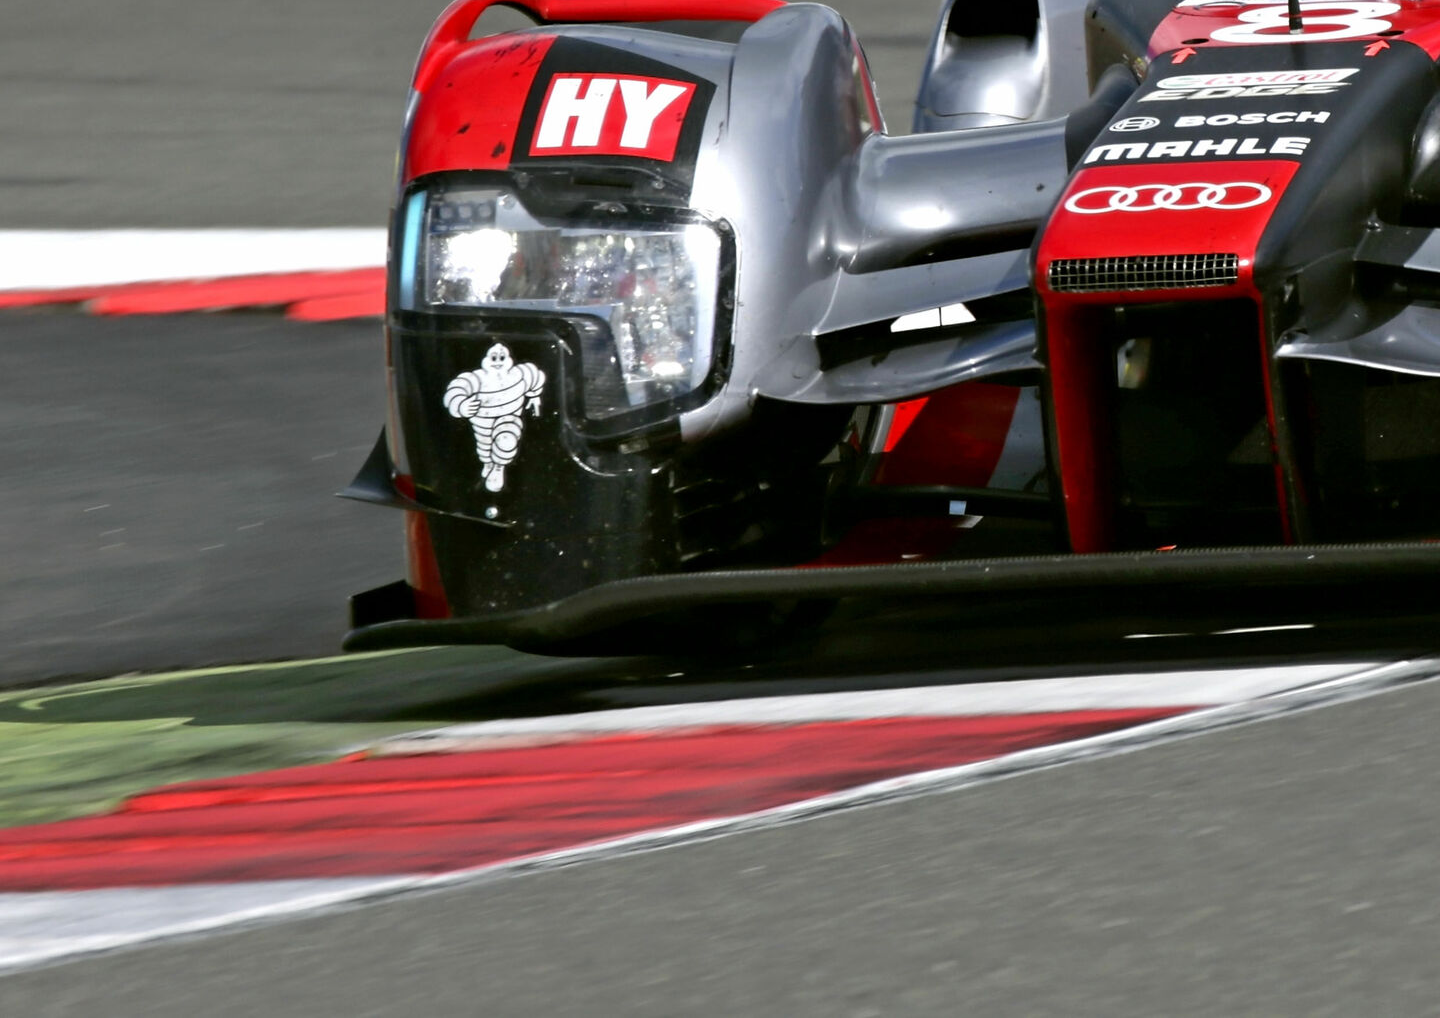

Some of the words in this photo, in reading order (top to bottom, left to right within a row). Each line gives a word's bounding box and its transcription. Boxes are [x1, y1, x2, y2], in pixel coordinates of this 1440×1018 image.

[1210, 1, 1401, 43] 8
[1137, 82, 1352, 103] EDGE
[536, 78, 687, 149] HY
[1174, 111, 1331, 128] BOSCH
[1084, 137, 1312, 165] MAHLE
